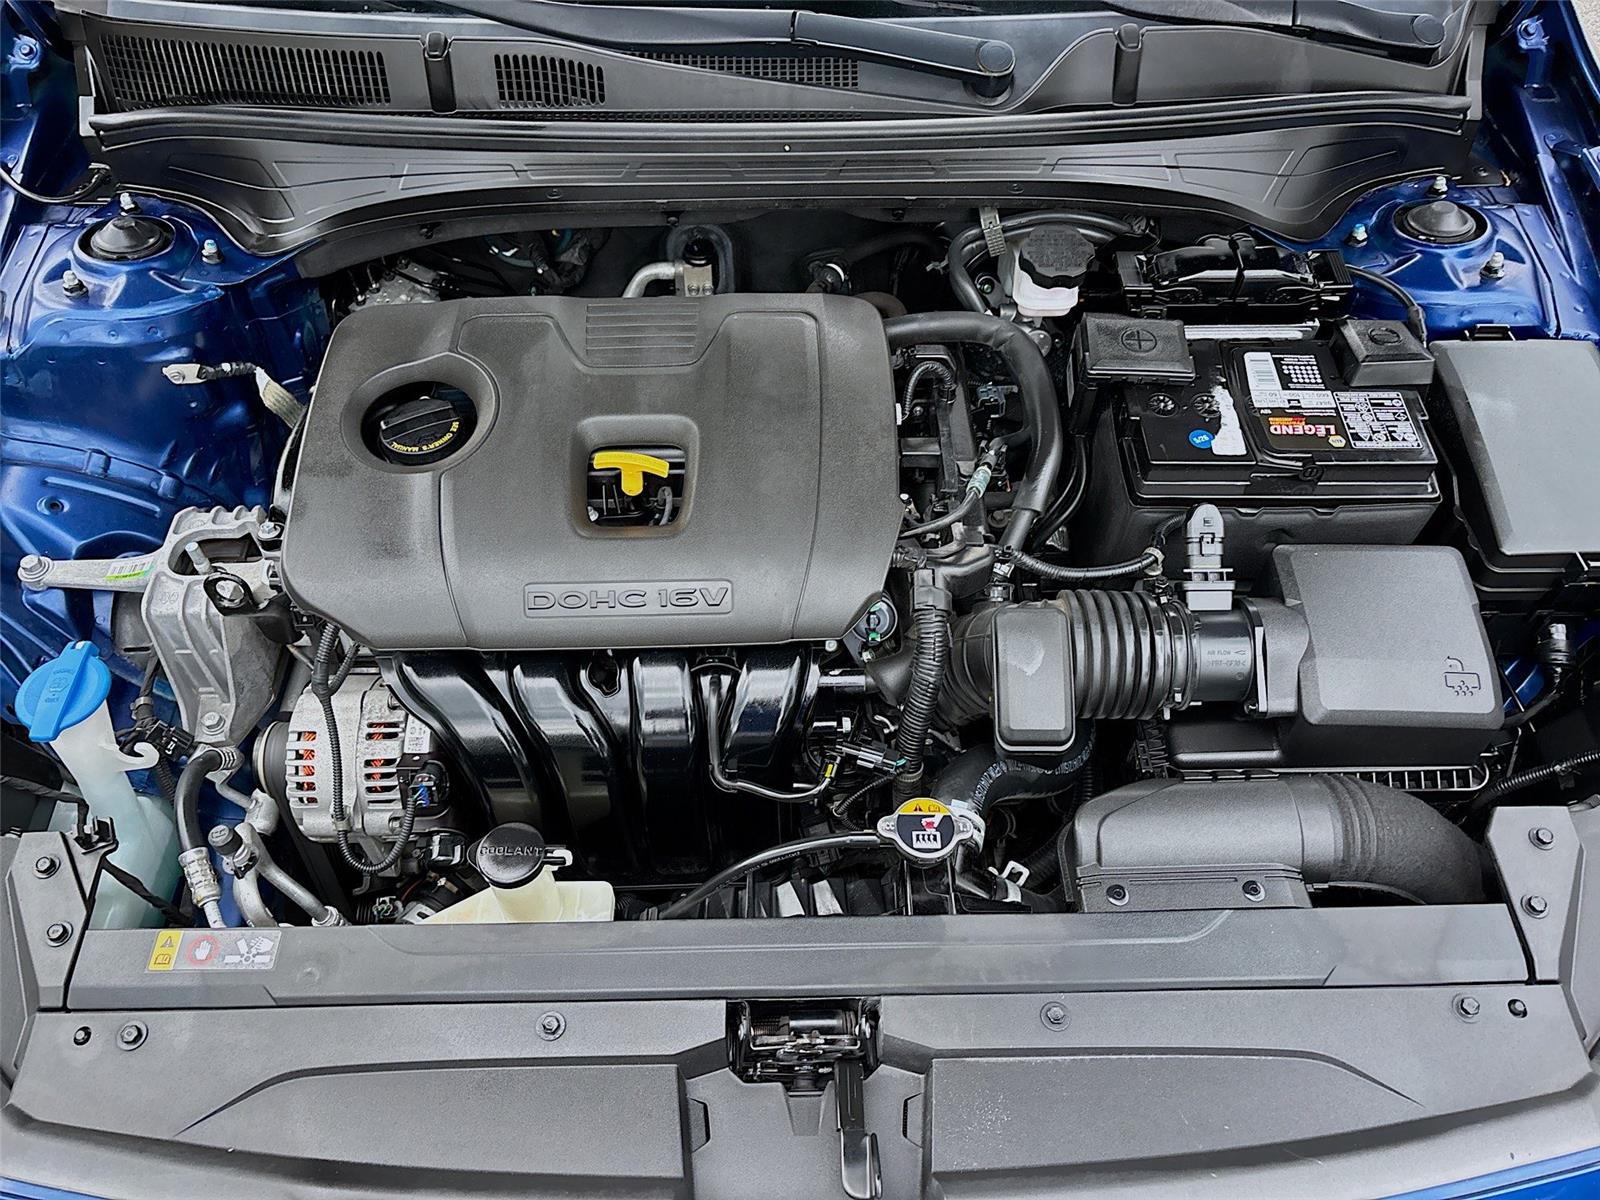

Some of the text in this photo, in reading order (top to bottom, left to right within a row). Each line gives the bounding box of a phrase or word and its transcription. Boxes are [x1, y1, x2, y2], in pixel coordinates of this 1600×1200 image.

[1269, 424, 1336, 435] LEGEND
[390, 441, 419, 452] MANUAL
[421, 432, 453, 451] OWNER'S
[527, 586, 729, 611] DOHC 16V
[480, 846, 543, 856] COOLANT
